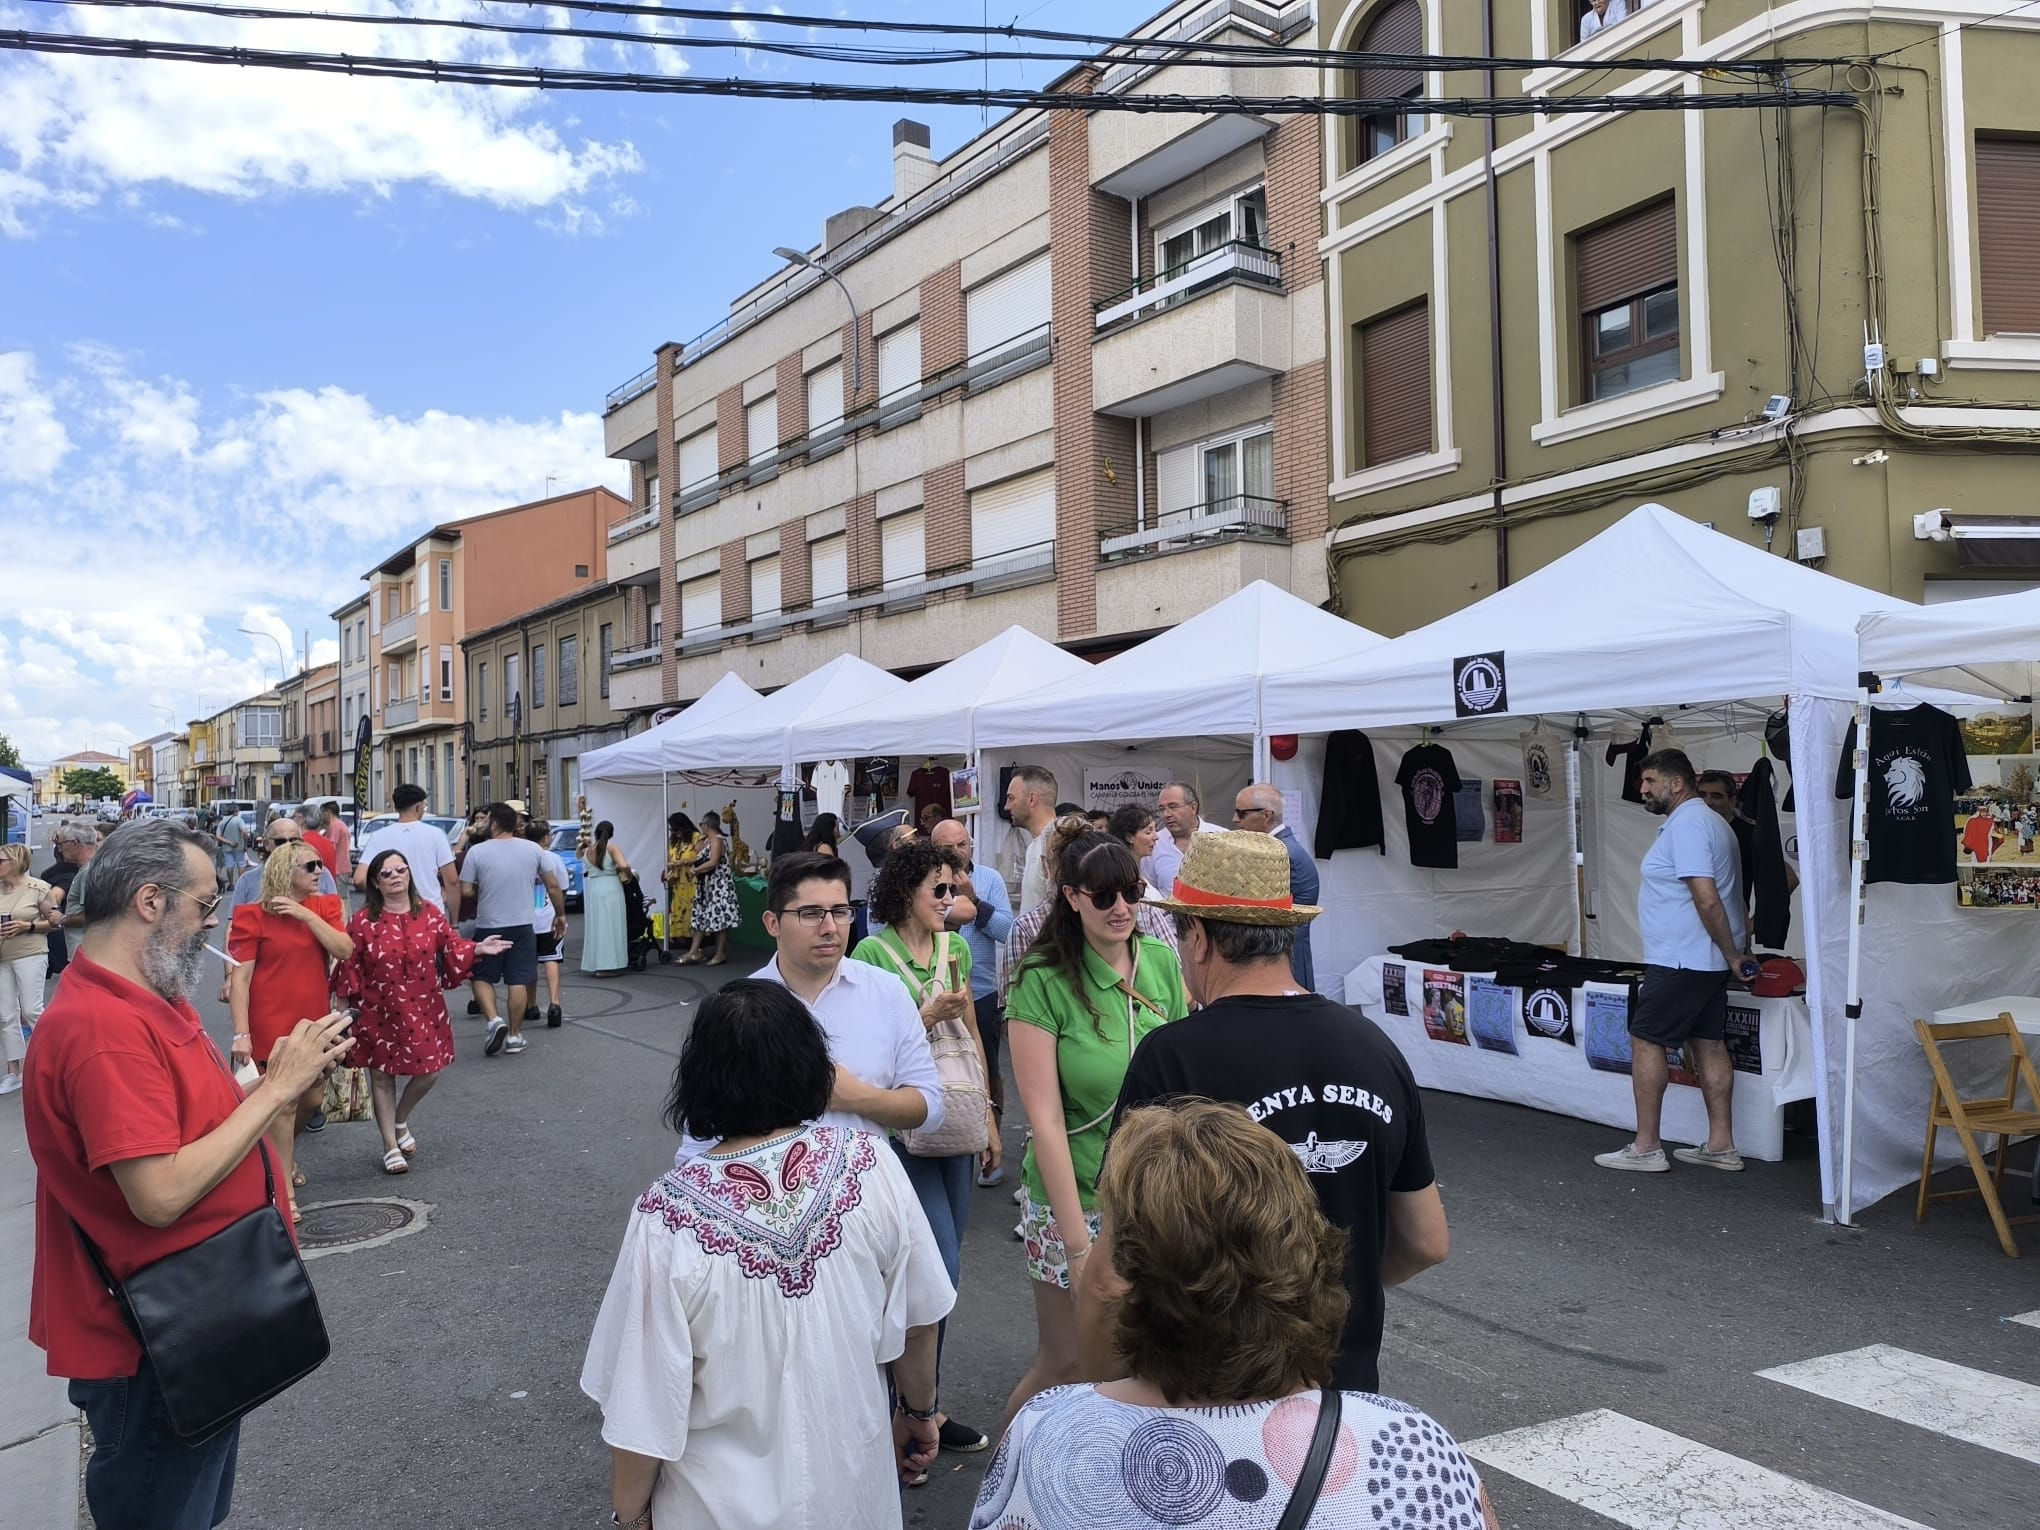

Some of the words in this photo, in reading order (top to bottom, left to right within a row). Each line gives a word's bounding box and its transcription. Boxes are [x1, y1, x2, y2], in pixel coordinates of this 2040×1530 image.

[1090, 782, 1120, 791] Manos
[1727, 1011, 1759, 1026] XXXIII
[1246, 1084, 1316, 1124] ENYA
[1322, 1084, 1394, 1125] SERES
